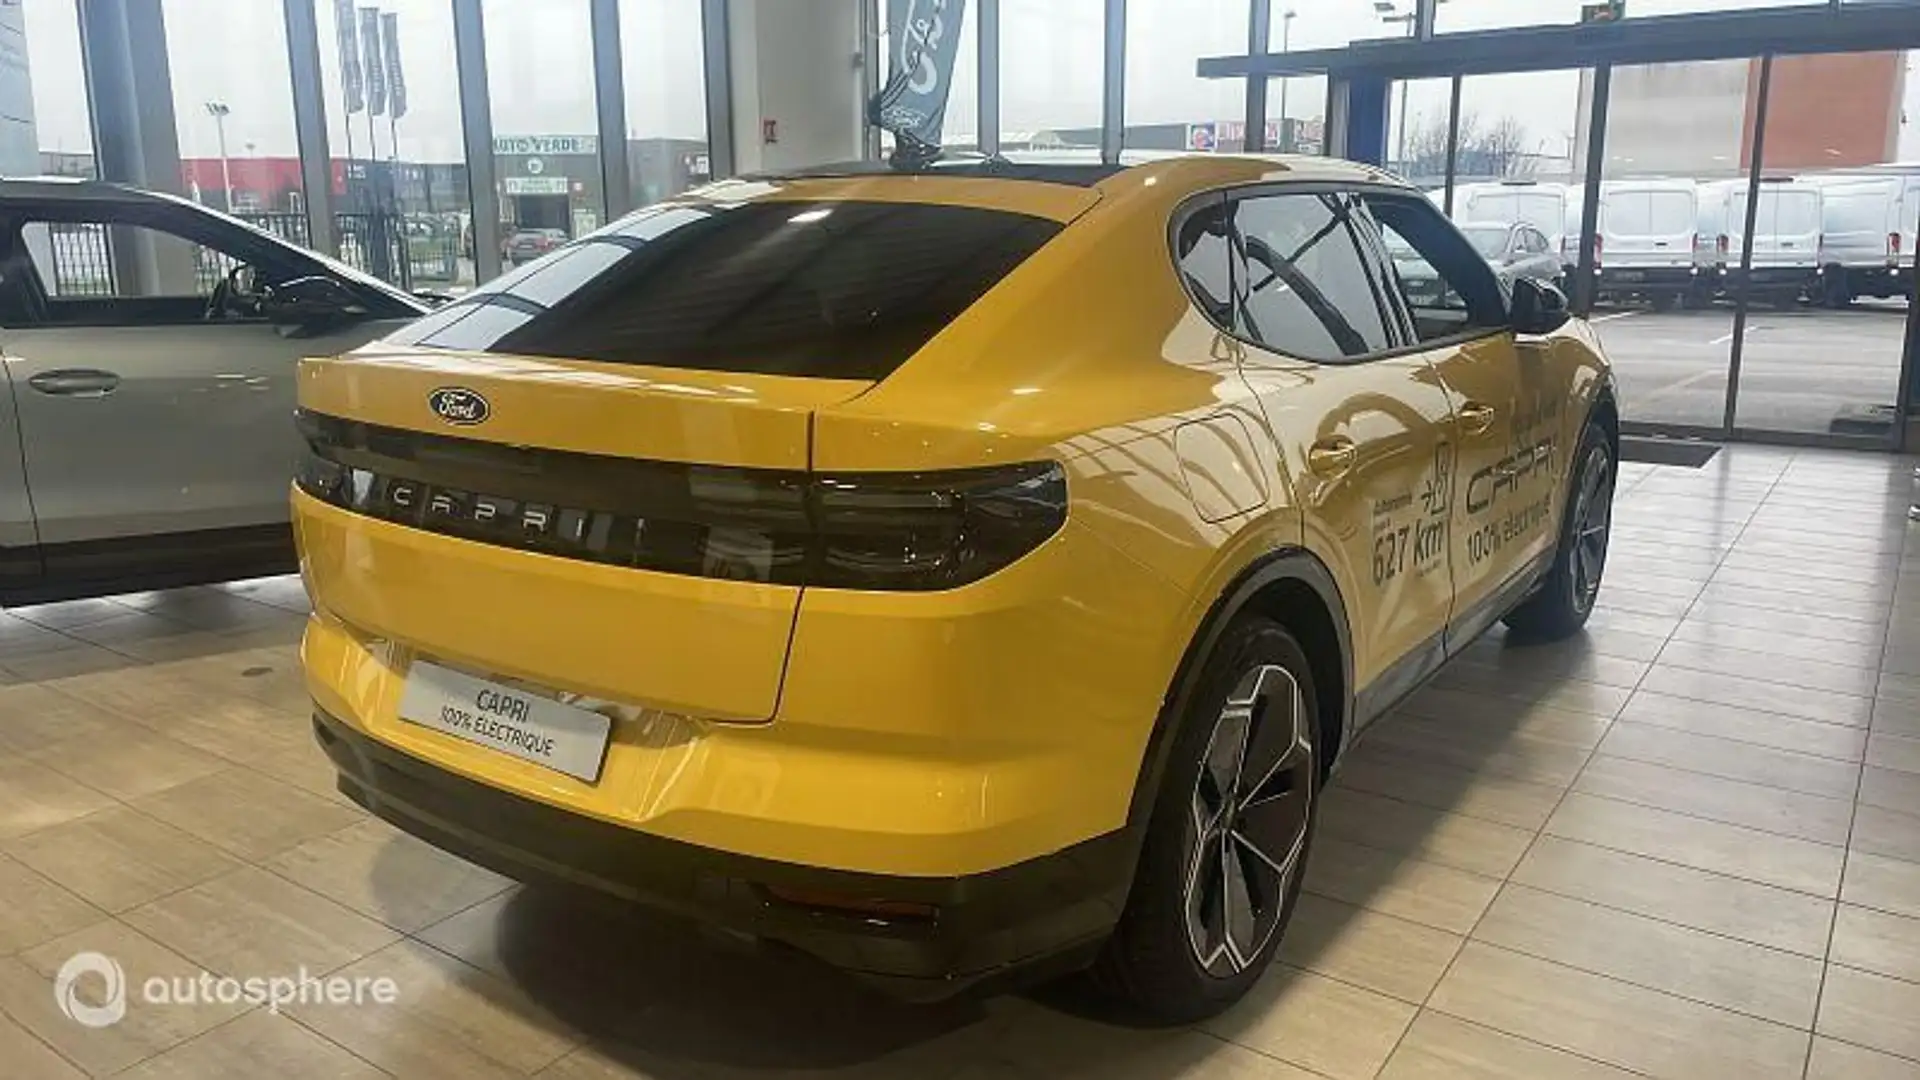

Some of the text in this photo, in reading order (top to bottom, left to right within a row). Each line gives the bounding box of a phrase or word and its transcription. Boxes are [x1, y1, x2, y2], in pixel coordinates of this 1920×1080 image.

[438, 391, 478, 419] Ford
[393, 486, 584, 538] CAPRI
[1373, 518, 1443, 586] 627 km
[441, 704, 472, 731] 100%
[476, 689, 530, 723] CAPRI
